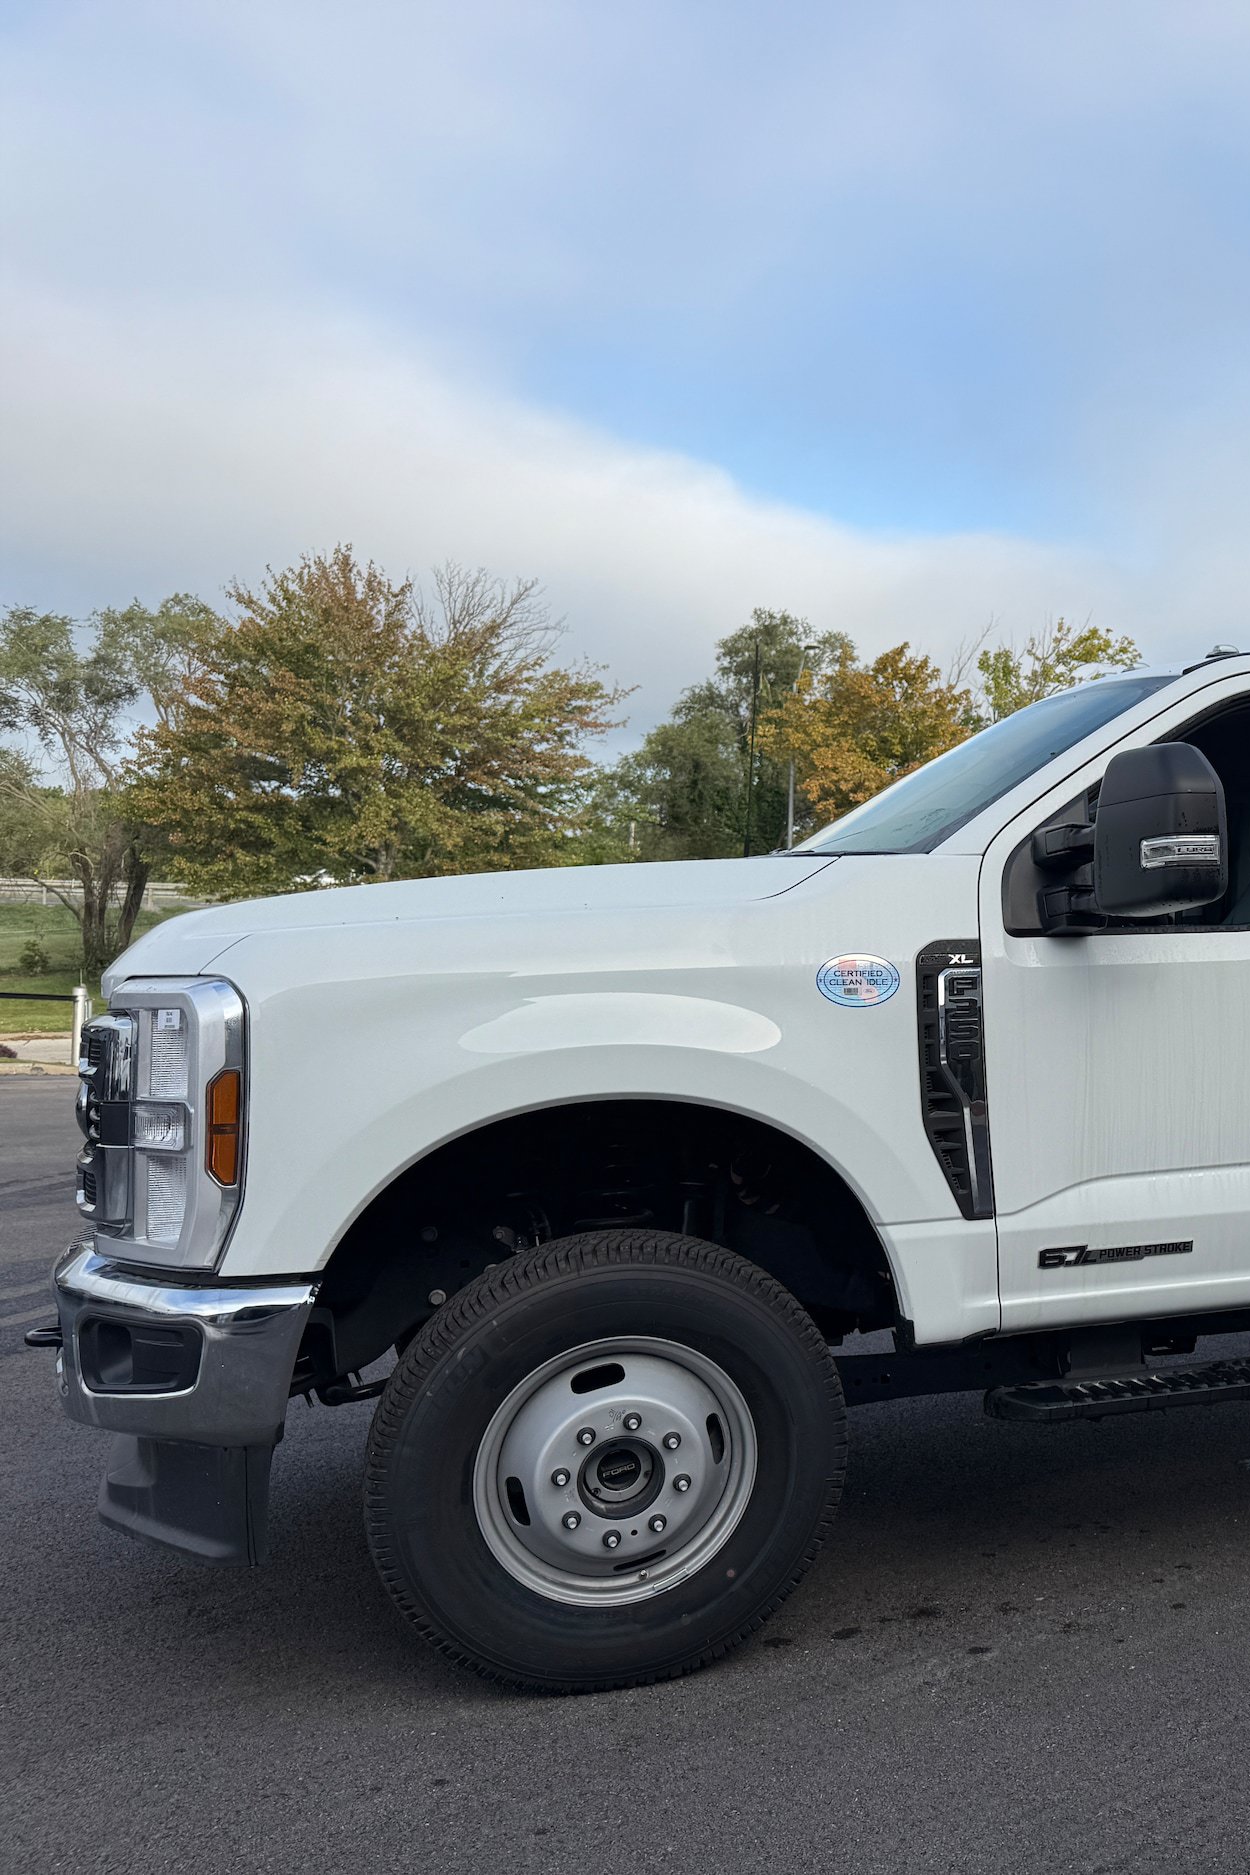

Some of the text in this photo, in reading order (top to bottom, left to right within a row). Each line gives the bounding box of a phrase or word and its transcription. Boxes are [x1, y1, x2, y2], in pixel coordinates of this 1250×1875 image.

[948, 954, 974, 965] XL
[829, 978, 888, 986] CLEAN IDLE
[1100, 1246, 1142, 1259] POWER
[1145, 1241, 1192, 1256] STROKE
[602, 1463, 636, 1478] FORD
